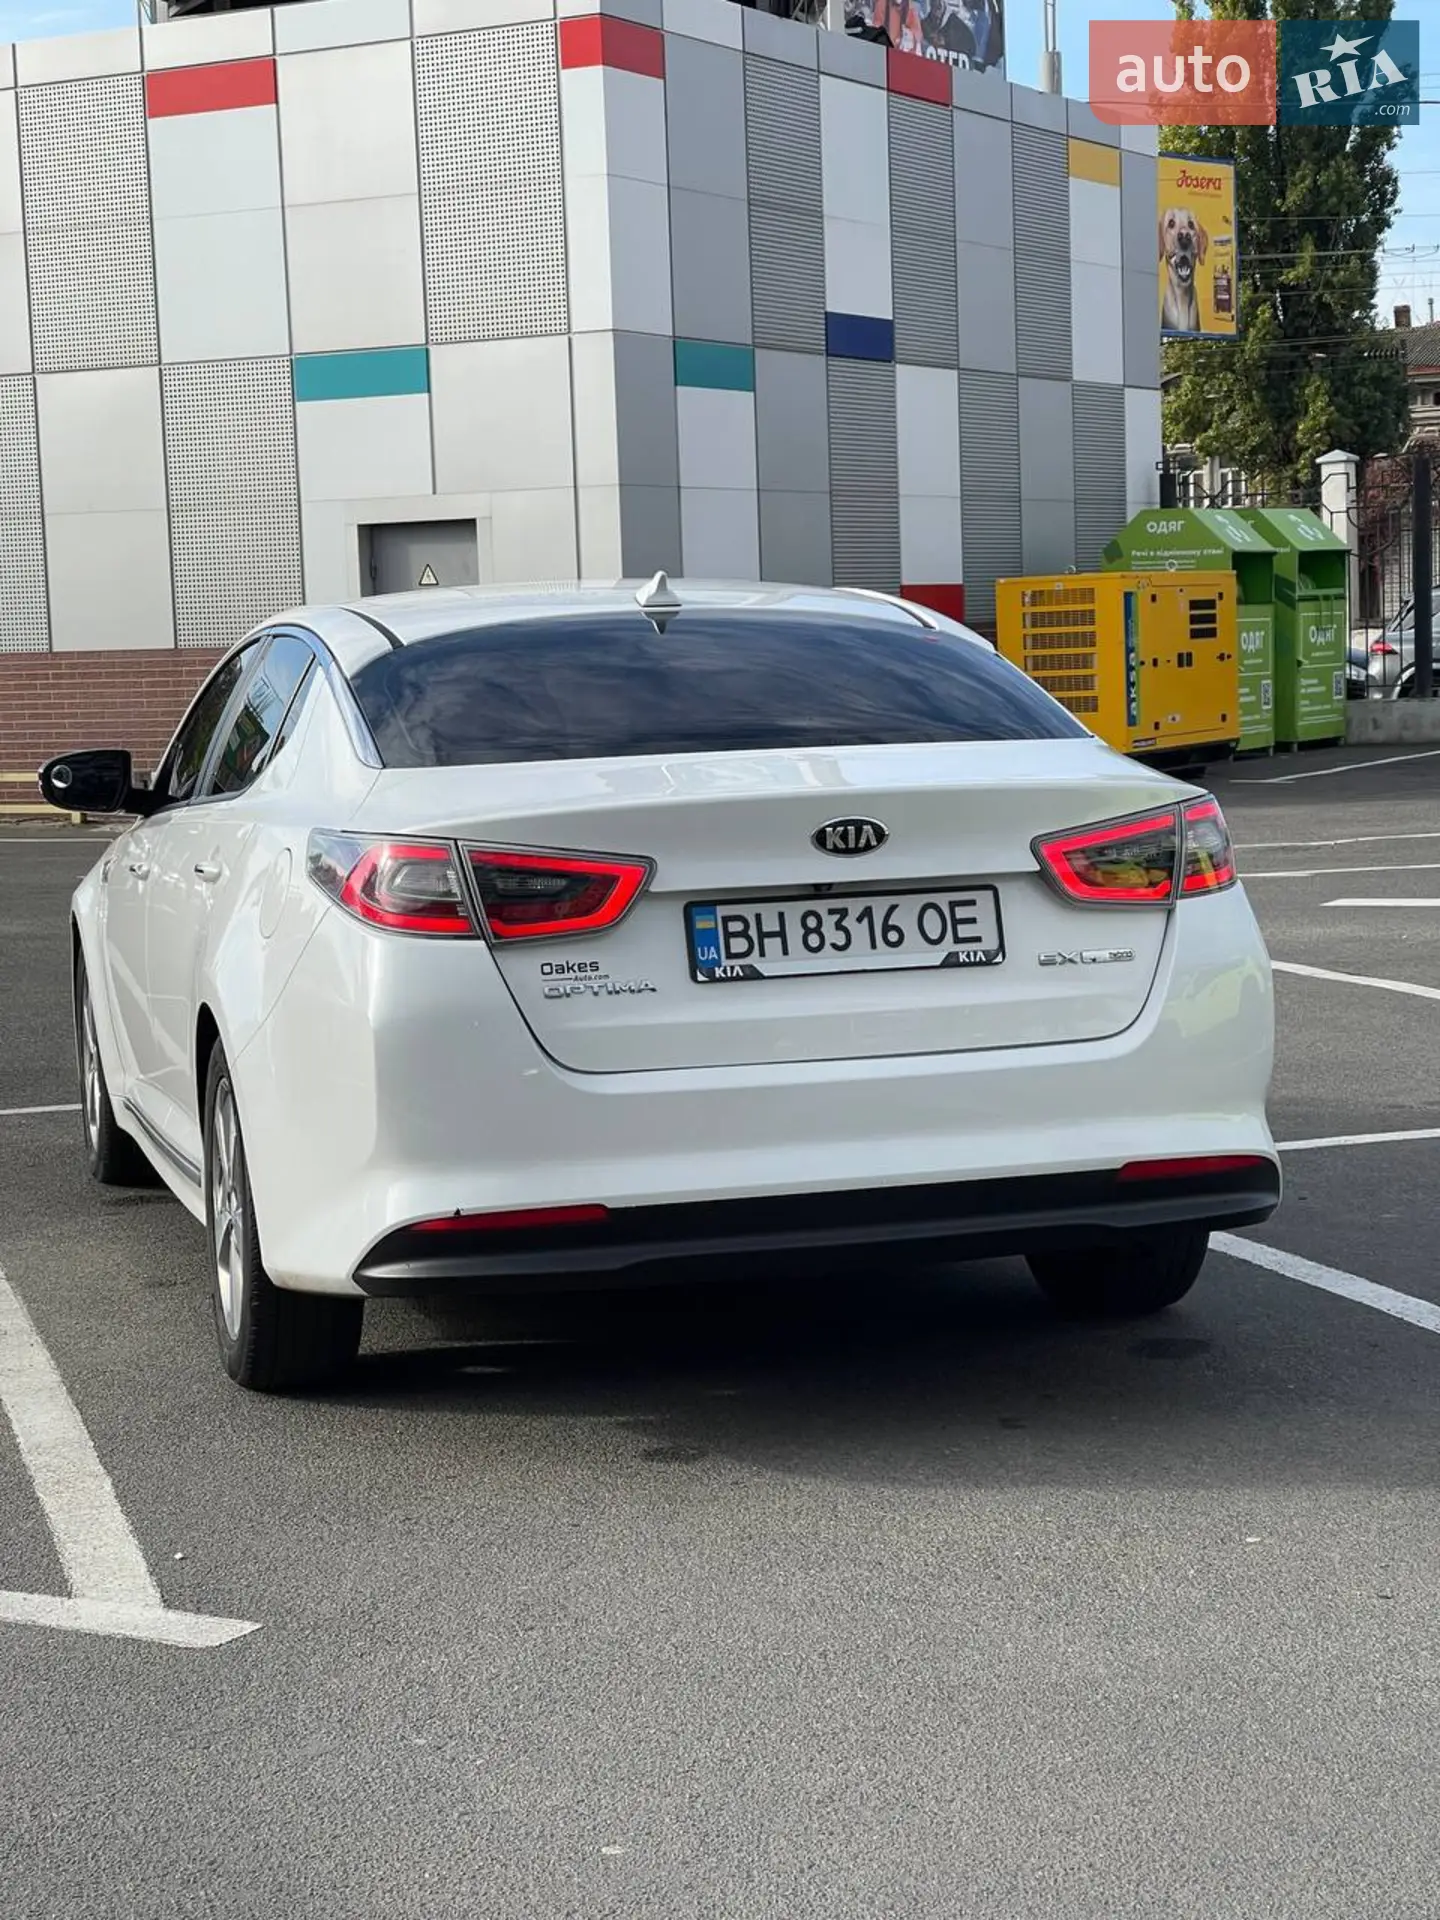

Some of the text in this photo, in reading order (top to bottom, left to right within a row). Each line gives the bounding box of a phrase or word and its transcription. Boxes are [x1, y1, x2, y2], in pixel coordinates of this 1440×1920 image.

[1176, 169, 1222, 190] Josera
[1146, 520, 1185, 535] ОДЯГ
[1309, 624, 1337, 646] ОДЯГ
[825, 825, 878, 850] KIA
[721, 899, 984, 960] BH 8316 OE
[697, 946, 719, 961] UA
[958, 949, 987, 963] KIA
[540, 960, 600, 975] Oakes
[715, 965, 744, 979] KIA
[543, 980, 658, 999] OPTIMA
